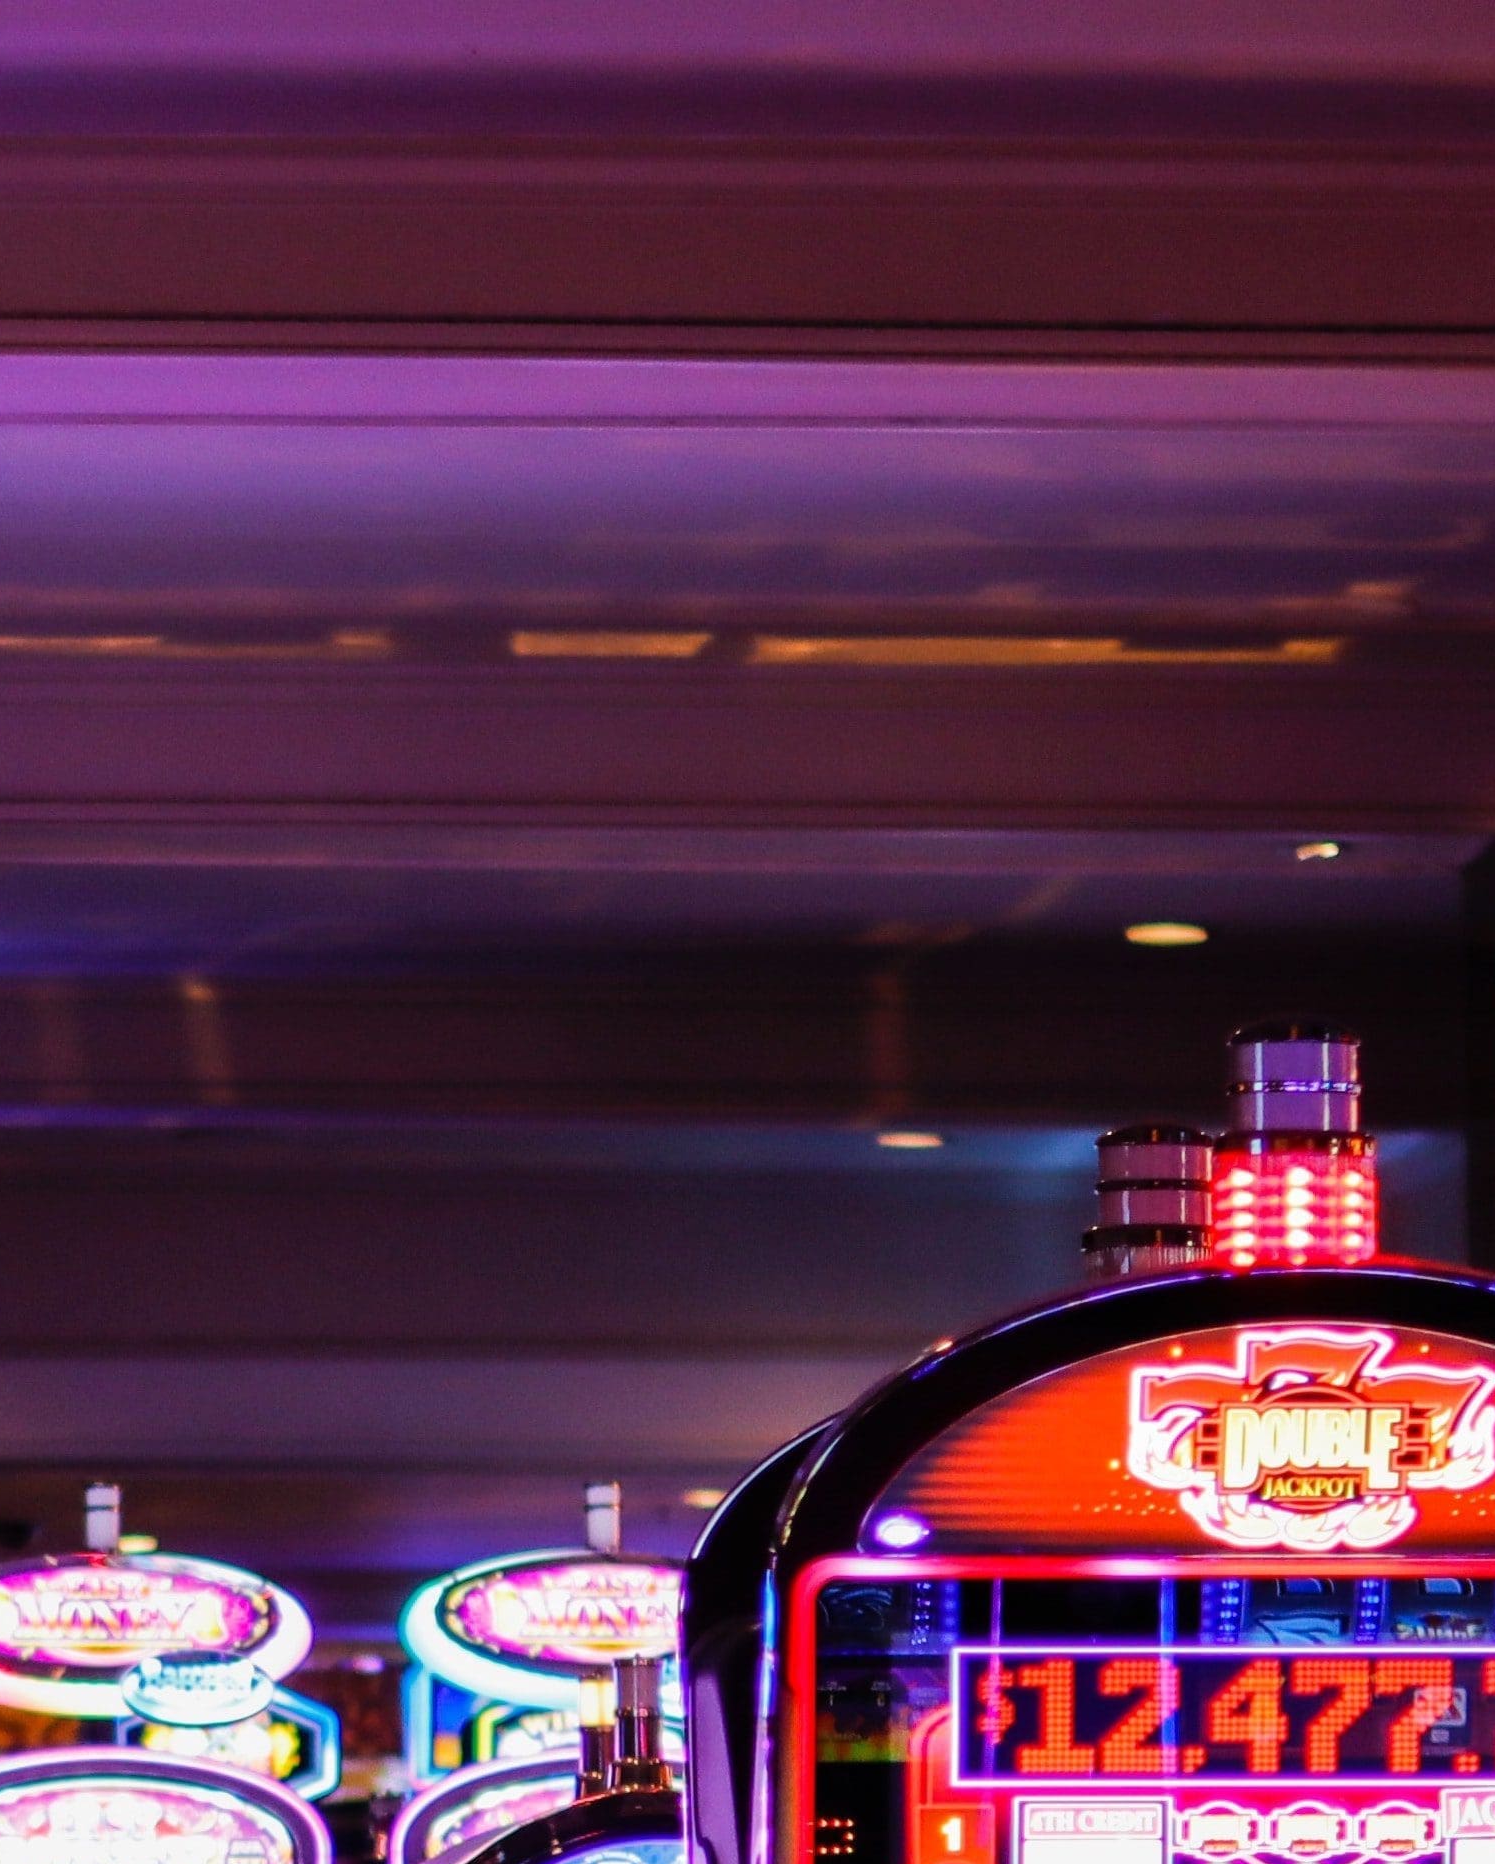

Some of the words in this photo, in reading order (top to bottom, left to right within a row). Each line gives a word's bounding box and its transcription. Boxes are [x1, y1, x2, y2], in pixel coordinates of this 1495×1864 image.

[1221, 1407, 1406, 1491] DOUBLE
[1261, 1475, 1357, 1501] JACKPOT
[13, 1597, 195, 1640] MONEY
[524, 1599, 679, 1638] MONE
[940, 1816, 962, 1852] 1
[1078, 1810, 1156, 1832] CREDIT
